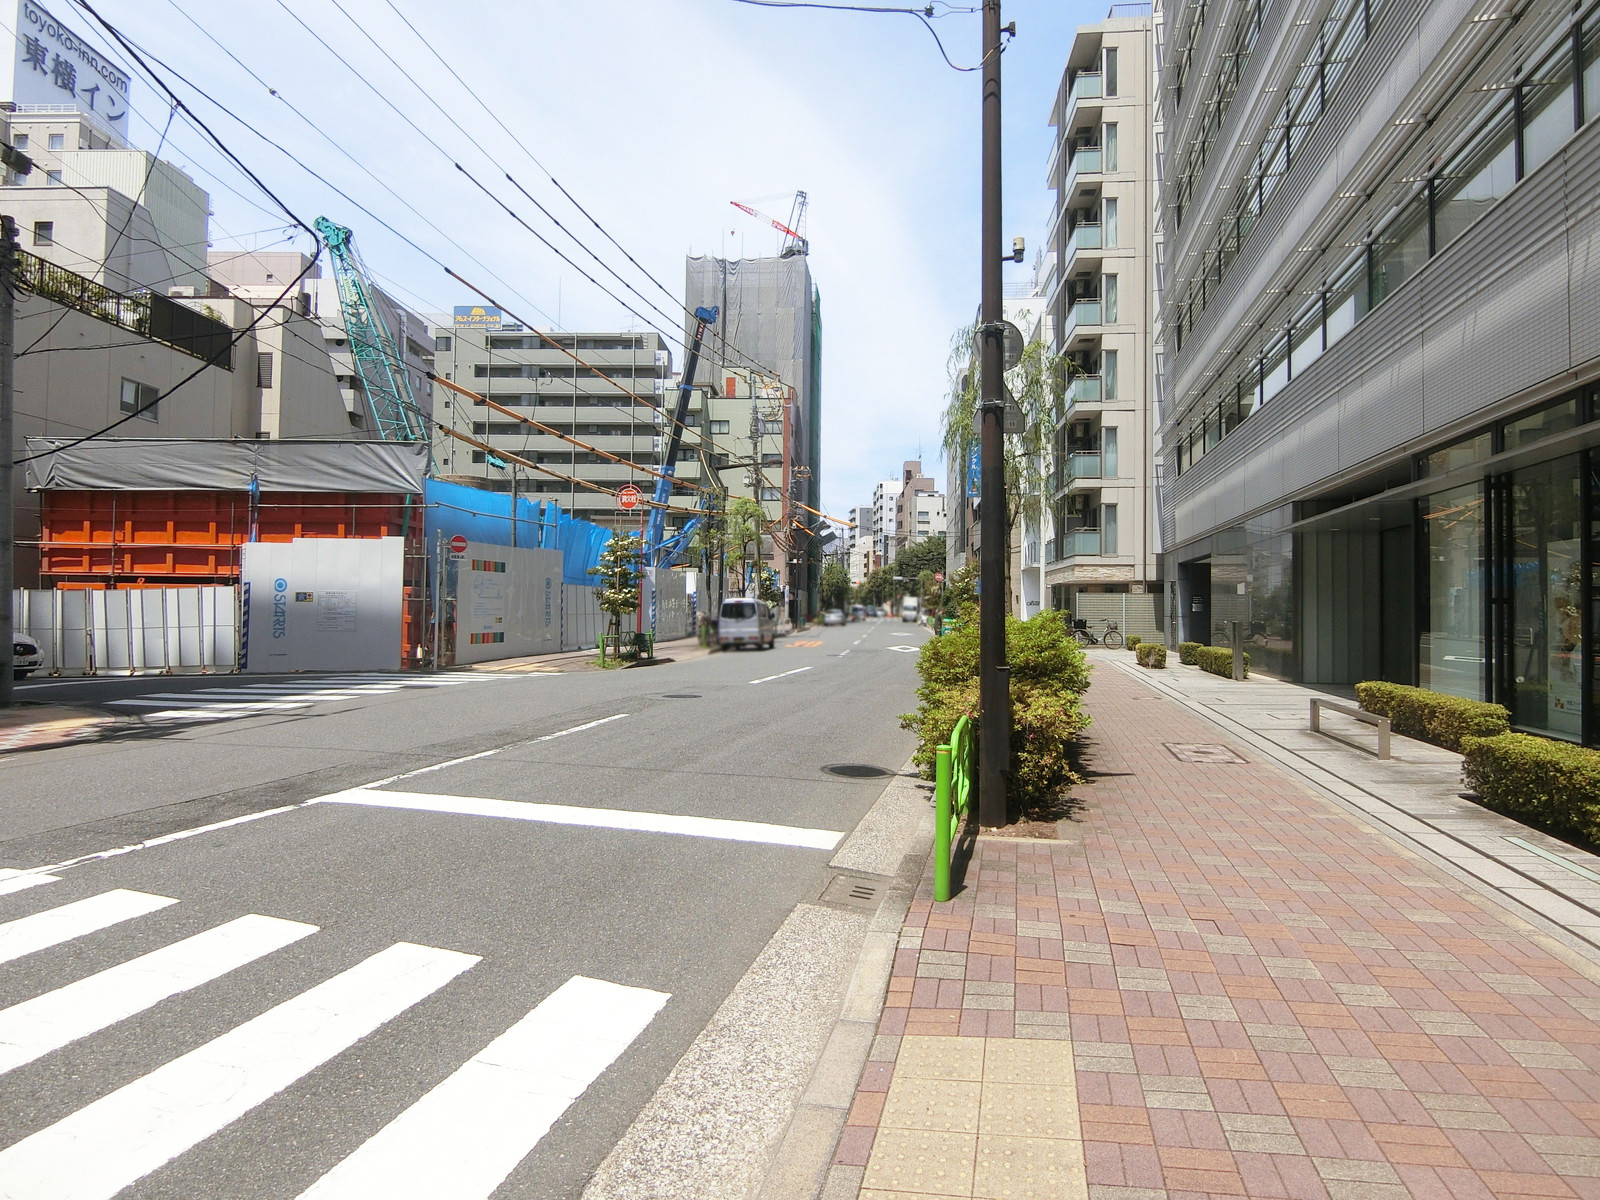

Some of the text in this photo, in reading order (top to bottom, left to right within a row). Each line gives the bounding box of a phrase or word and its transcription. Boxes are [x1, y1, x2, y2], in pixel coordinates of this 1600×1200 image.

[22, 33, 126, 122] 東横イン
[24, 2, 128, 93] toyoko-inn.com
